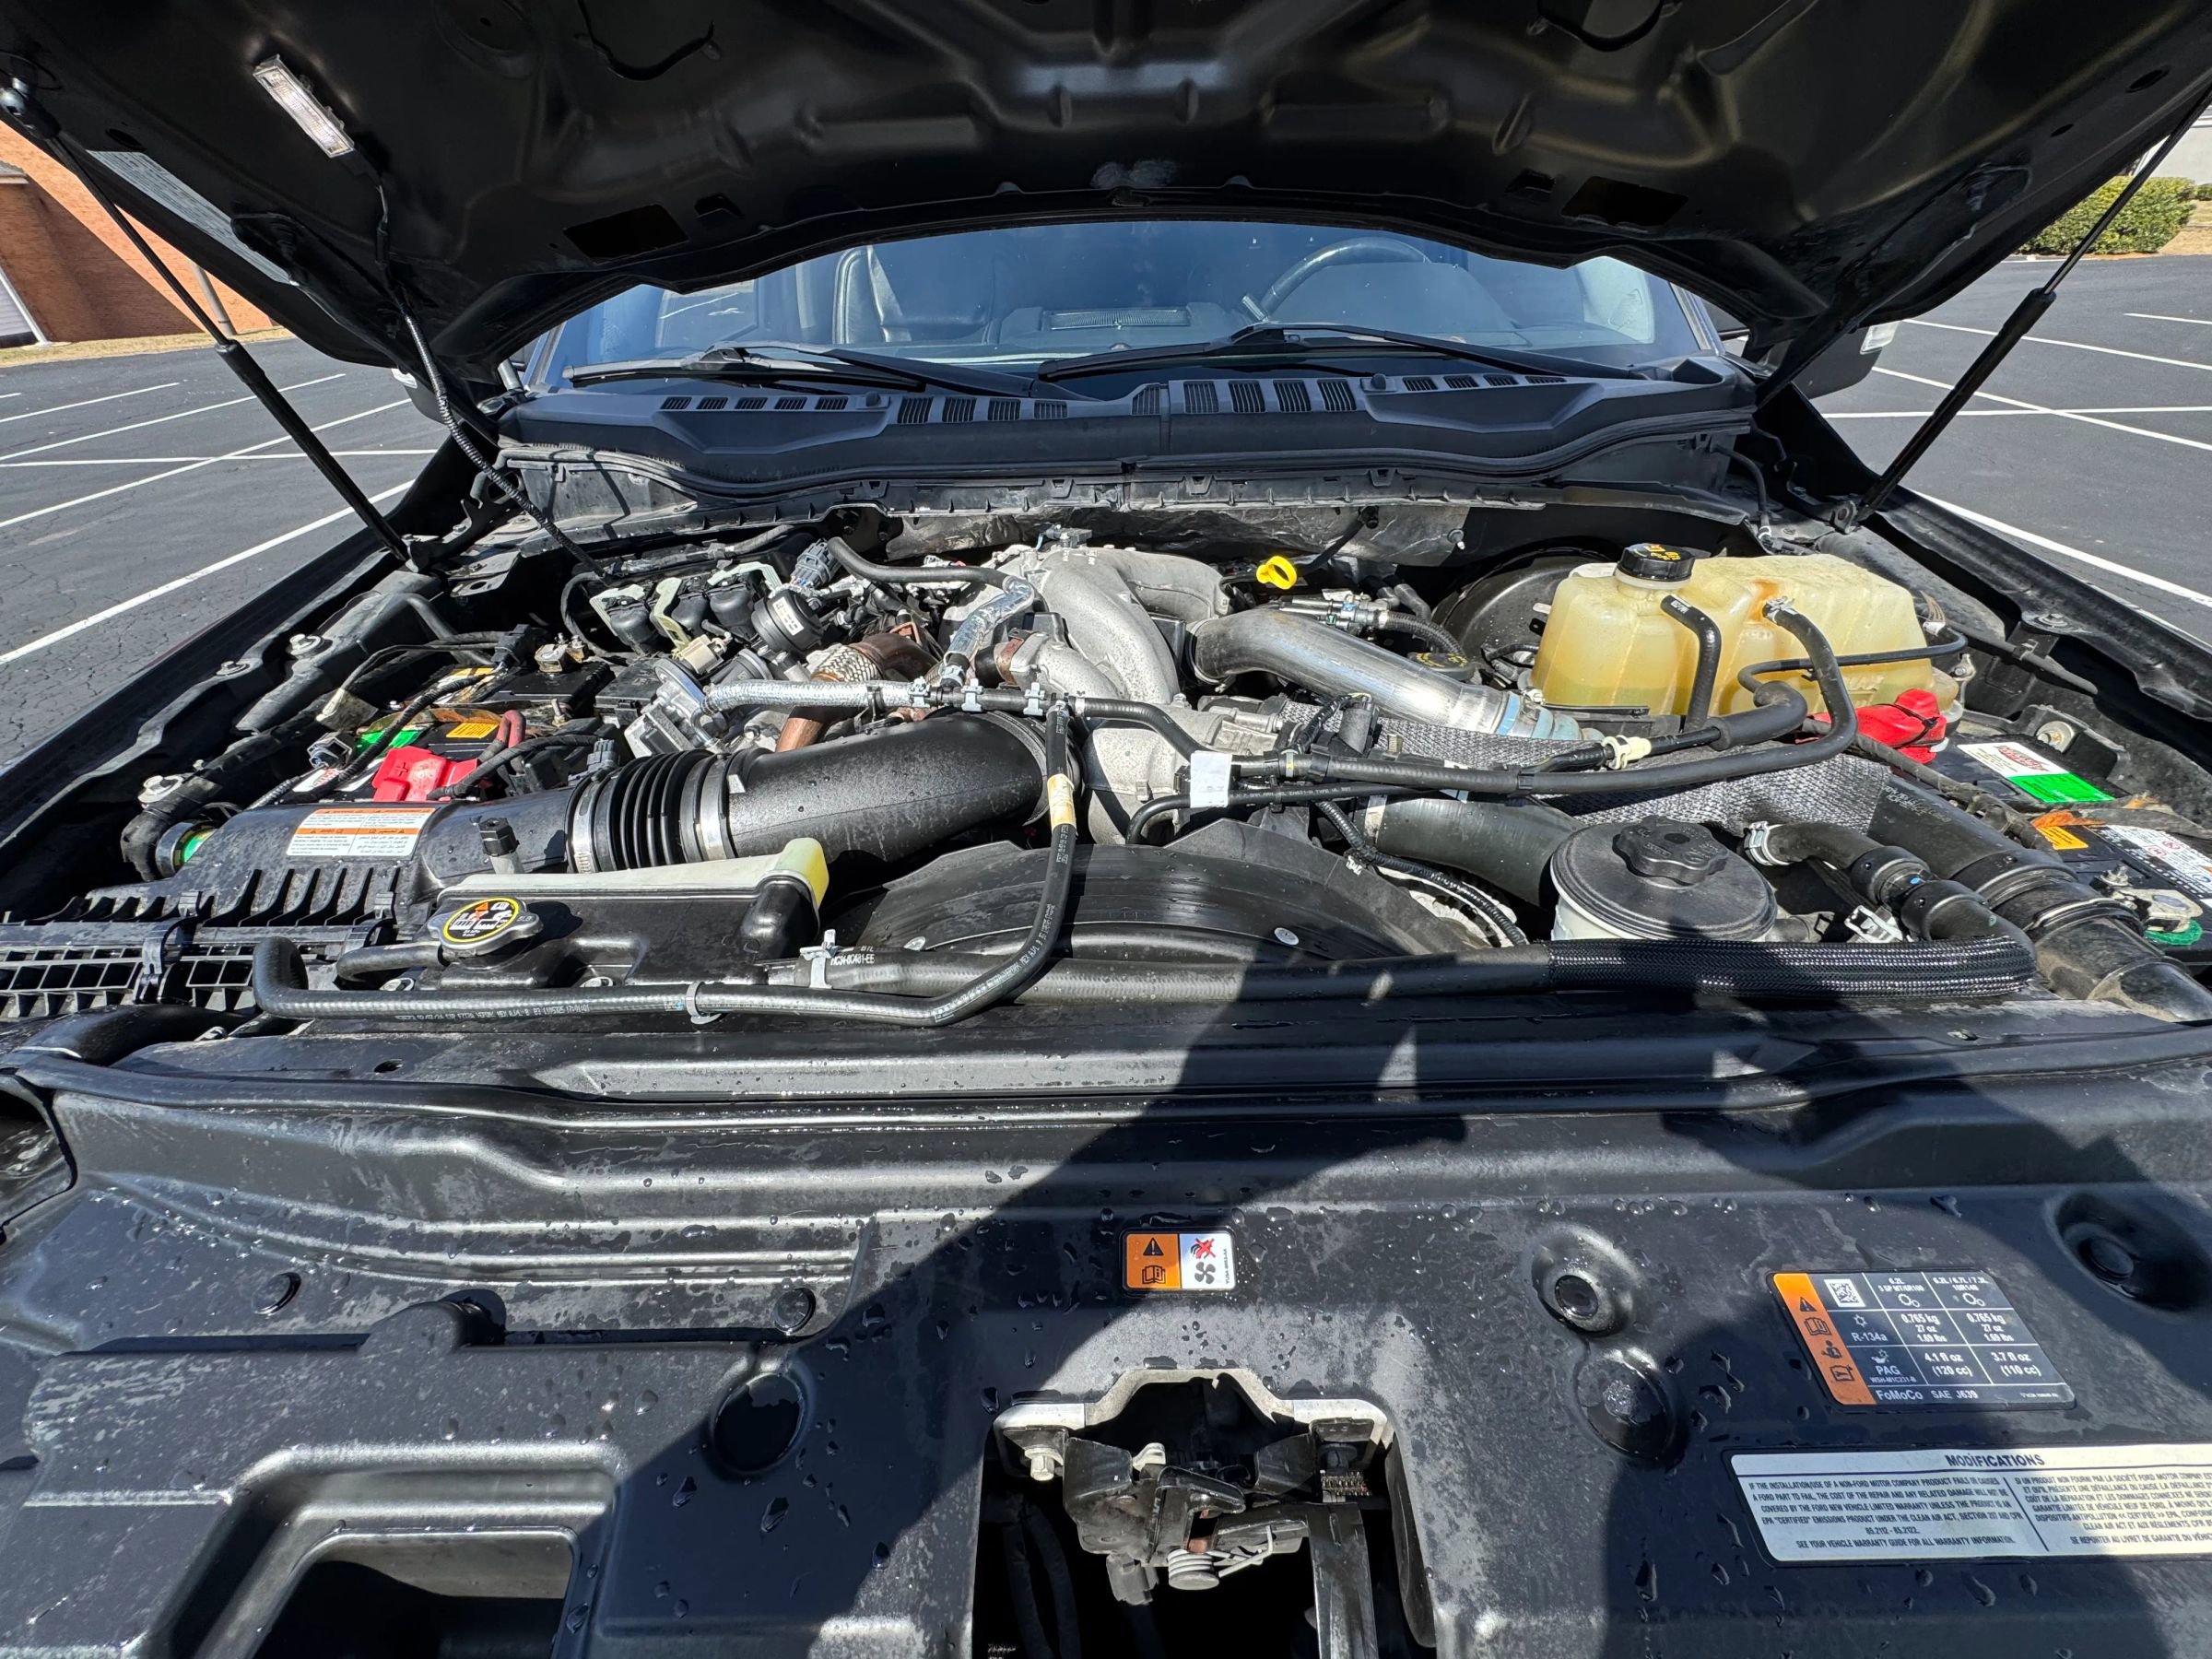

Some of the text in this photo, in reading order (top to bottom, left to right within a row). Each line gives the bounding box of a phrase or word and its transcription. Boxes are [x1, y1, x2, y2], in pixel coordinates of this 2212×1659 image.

[1900, 1313, 1940, 1325] 0.765 kg
[1966, 1313, 2006, 1324] 0.765 kg
[1851, 1333, 1888, 1342] R-134a
[1934, 1335, 1947, 1343] lbs
[2000, 1334, 2014, 1342] lbs
[1924, 1352, 1963, 1362] 4.1 fl oz
[1991, 1352, 2006, 1361] 3.7
[2007, 1352, 2018, 1361] fl
[1876, 1366, 1900, 1375] PAG
[1932, 1366, 1973, 1377] (120 cc)
[2000, 1365, 2041, 1377] (110 cc)
[1876, 1390, 1979, 1400] FoMoCo SAE J639
[1945, 1454, 2045, 1466] MODIFICATIONS
[1921, 1477, 1952, 1486] PRODUCT
[2032, 1504, 2062, 1512] GARANTIE
[1773, 1516, 1810, 1524] "CERTIFIED"
[1812, 1515, 1846, 1524] EMISSIONS
[1875, 1514, 1897, 1523] UNDER
[1943, 1513, 1960, 1522] ACT,
[2035, 1513, 2072, 1522] DISPOSITIFS
[2071, 1512, 2118, 1521] ANTIPOLLUTION
[1809, 1540, 1827, 1548] YOUR
[1827, 1539, 1853, 1547] VEHICLE
[1888, 1538, 1908, 1547] GUIDE
[1908, 1538, 1922, 1547] FOR
[1921, 1537, 1936, 1546] ALL
[1934, 1537, 1971, 1546] WARRANTY
[2120, 1535, 2141, 1543] LIVRET
[2141, 1535, 2151, 1543] DE
[2150, 1534, 2183, 1542] GARANTIE
